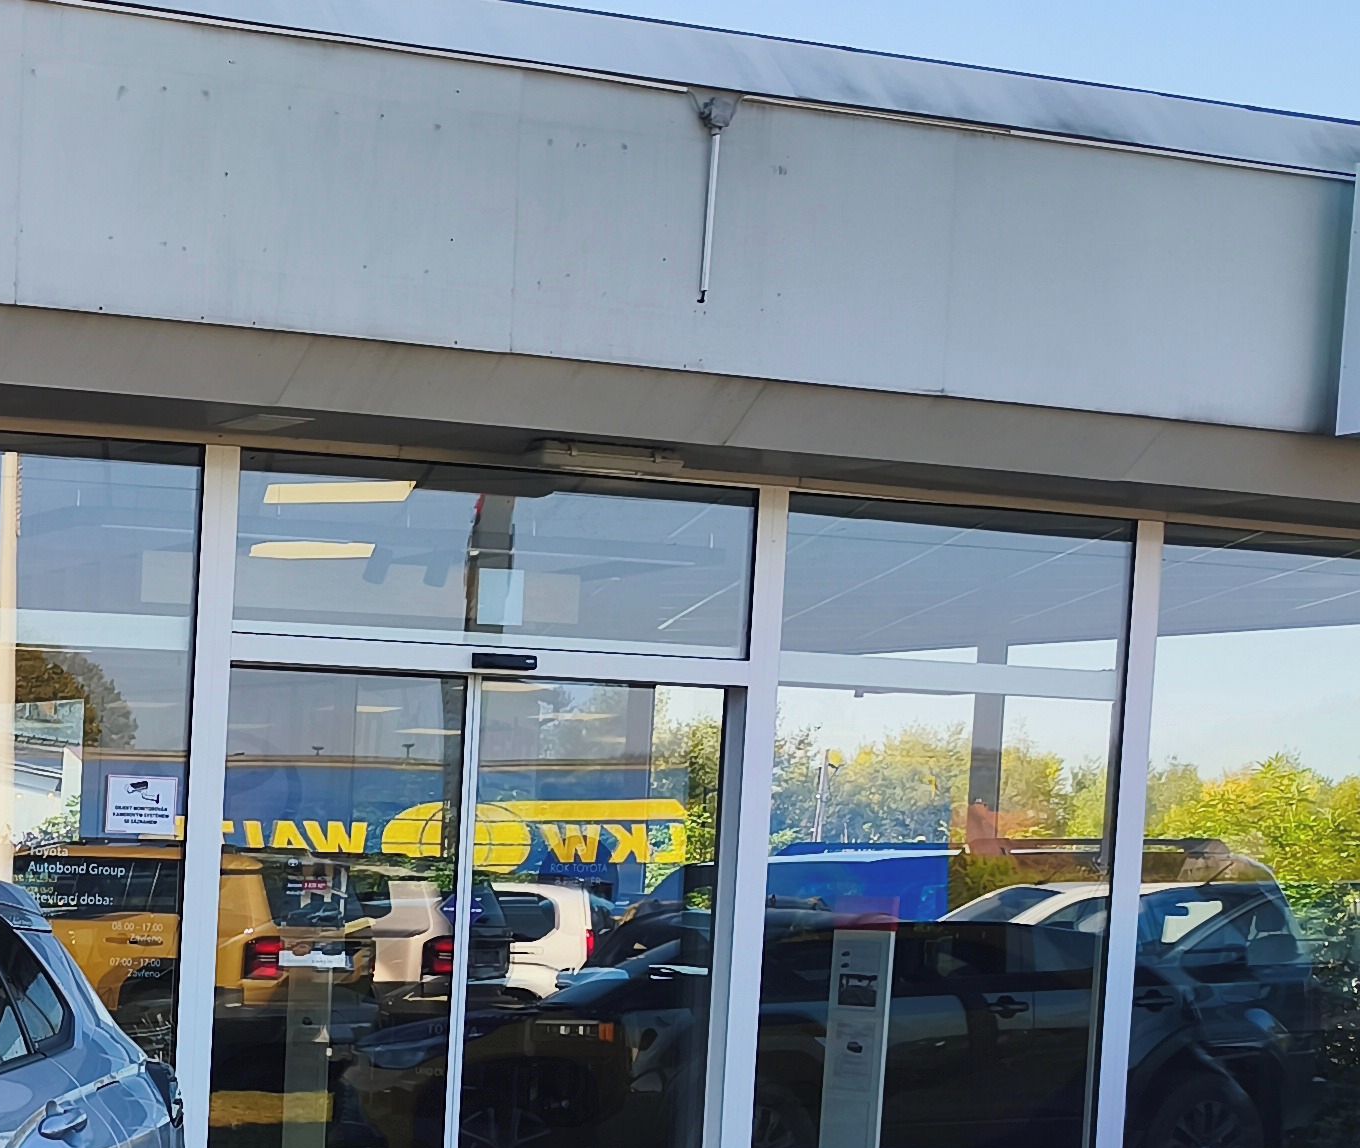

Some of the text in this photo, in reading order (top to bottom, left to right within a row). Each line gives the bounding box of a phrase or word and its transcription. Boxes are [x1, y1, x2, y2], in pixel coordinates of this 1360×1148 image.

[30, 846, 69, 858] Toyota
[28, 861, 126, 878] Autobond Group
[550, 864, 608, 872] ROK TOYOTA
[80, 893, 114, 906] doba:
[110, 957, 132, 966] 07:00
